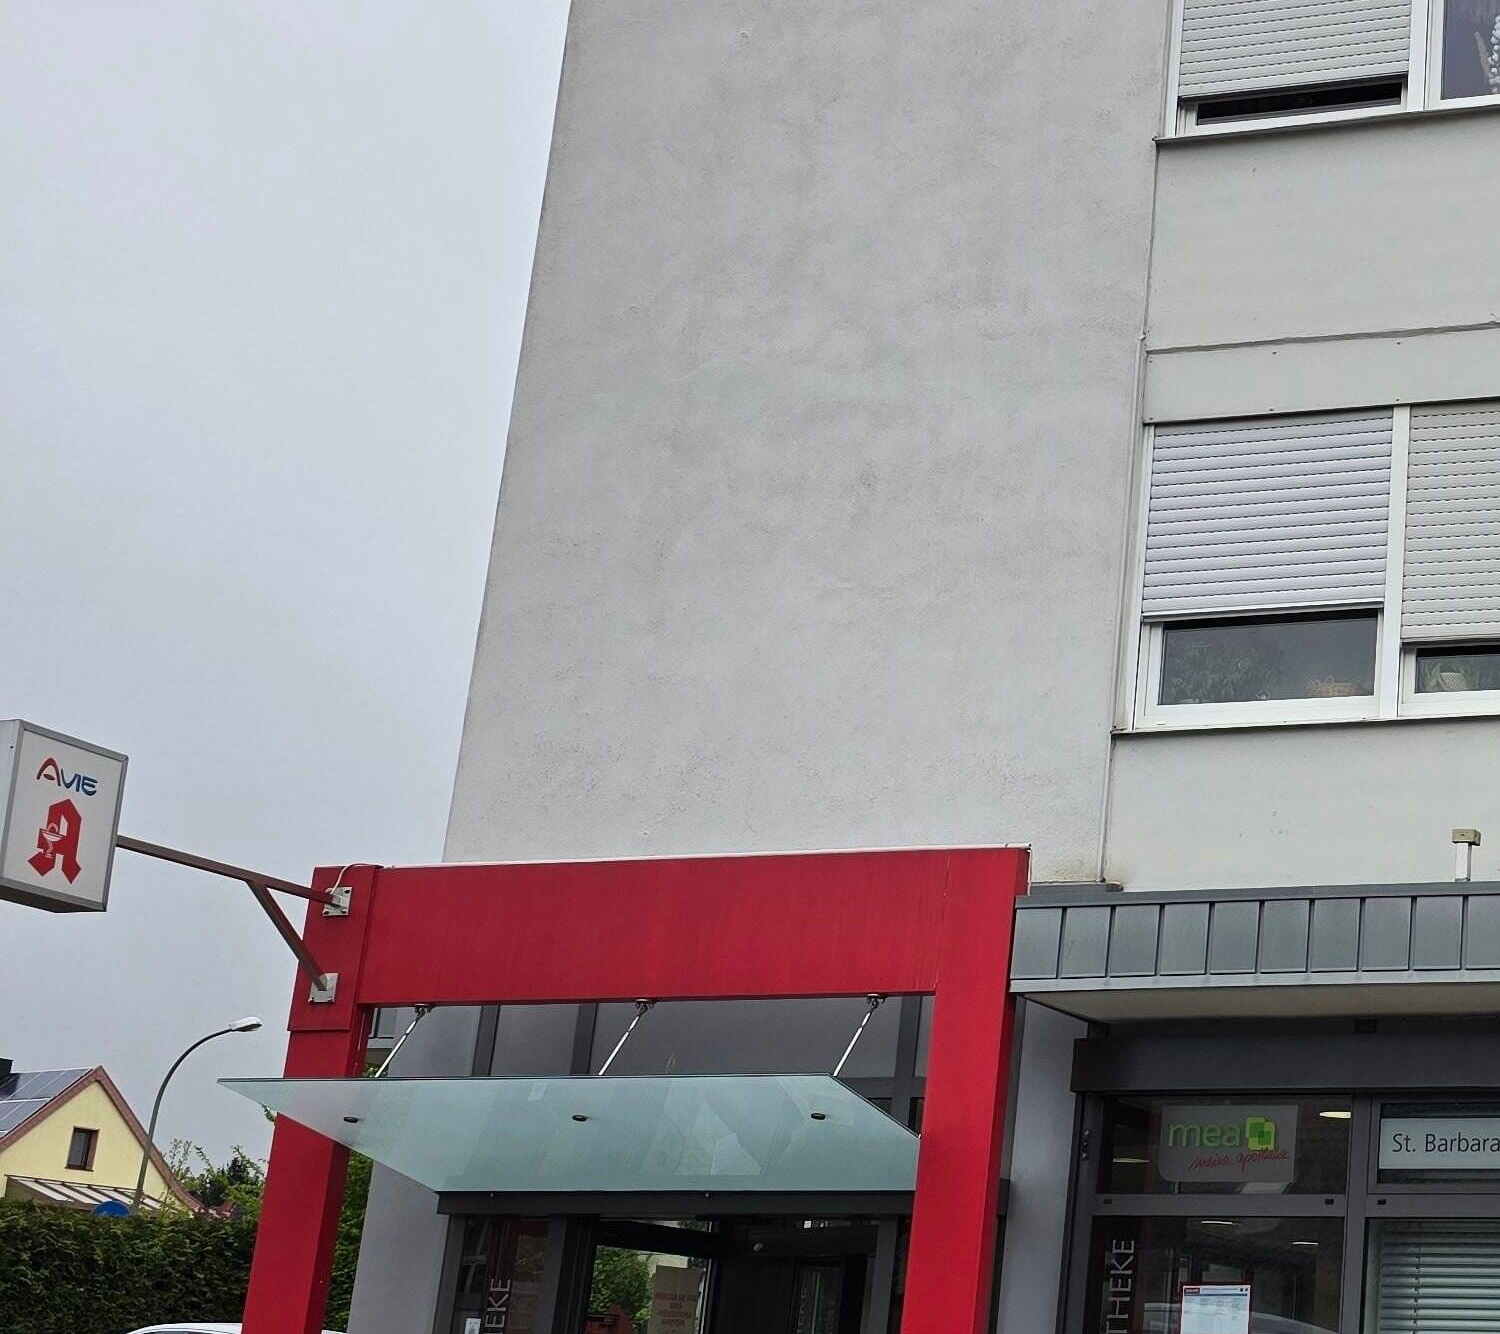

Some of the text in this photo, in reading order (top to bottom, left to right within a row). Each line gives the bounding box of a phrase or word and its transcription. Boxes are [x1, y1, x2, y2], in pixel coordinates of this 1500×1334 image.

[1167, 1122, 1241, 1147] mea
[1391, 1133, 1416, 1153] St.
[1425, 1132, 1500, 1153] Barbara
